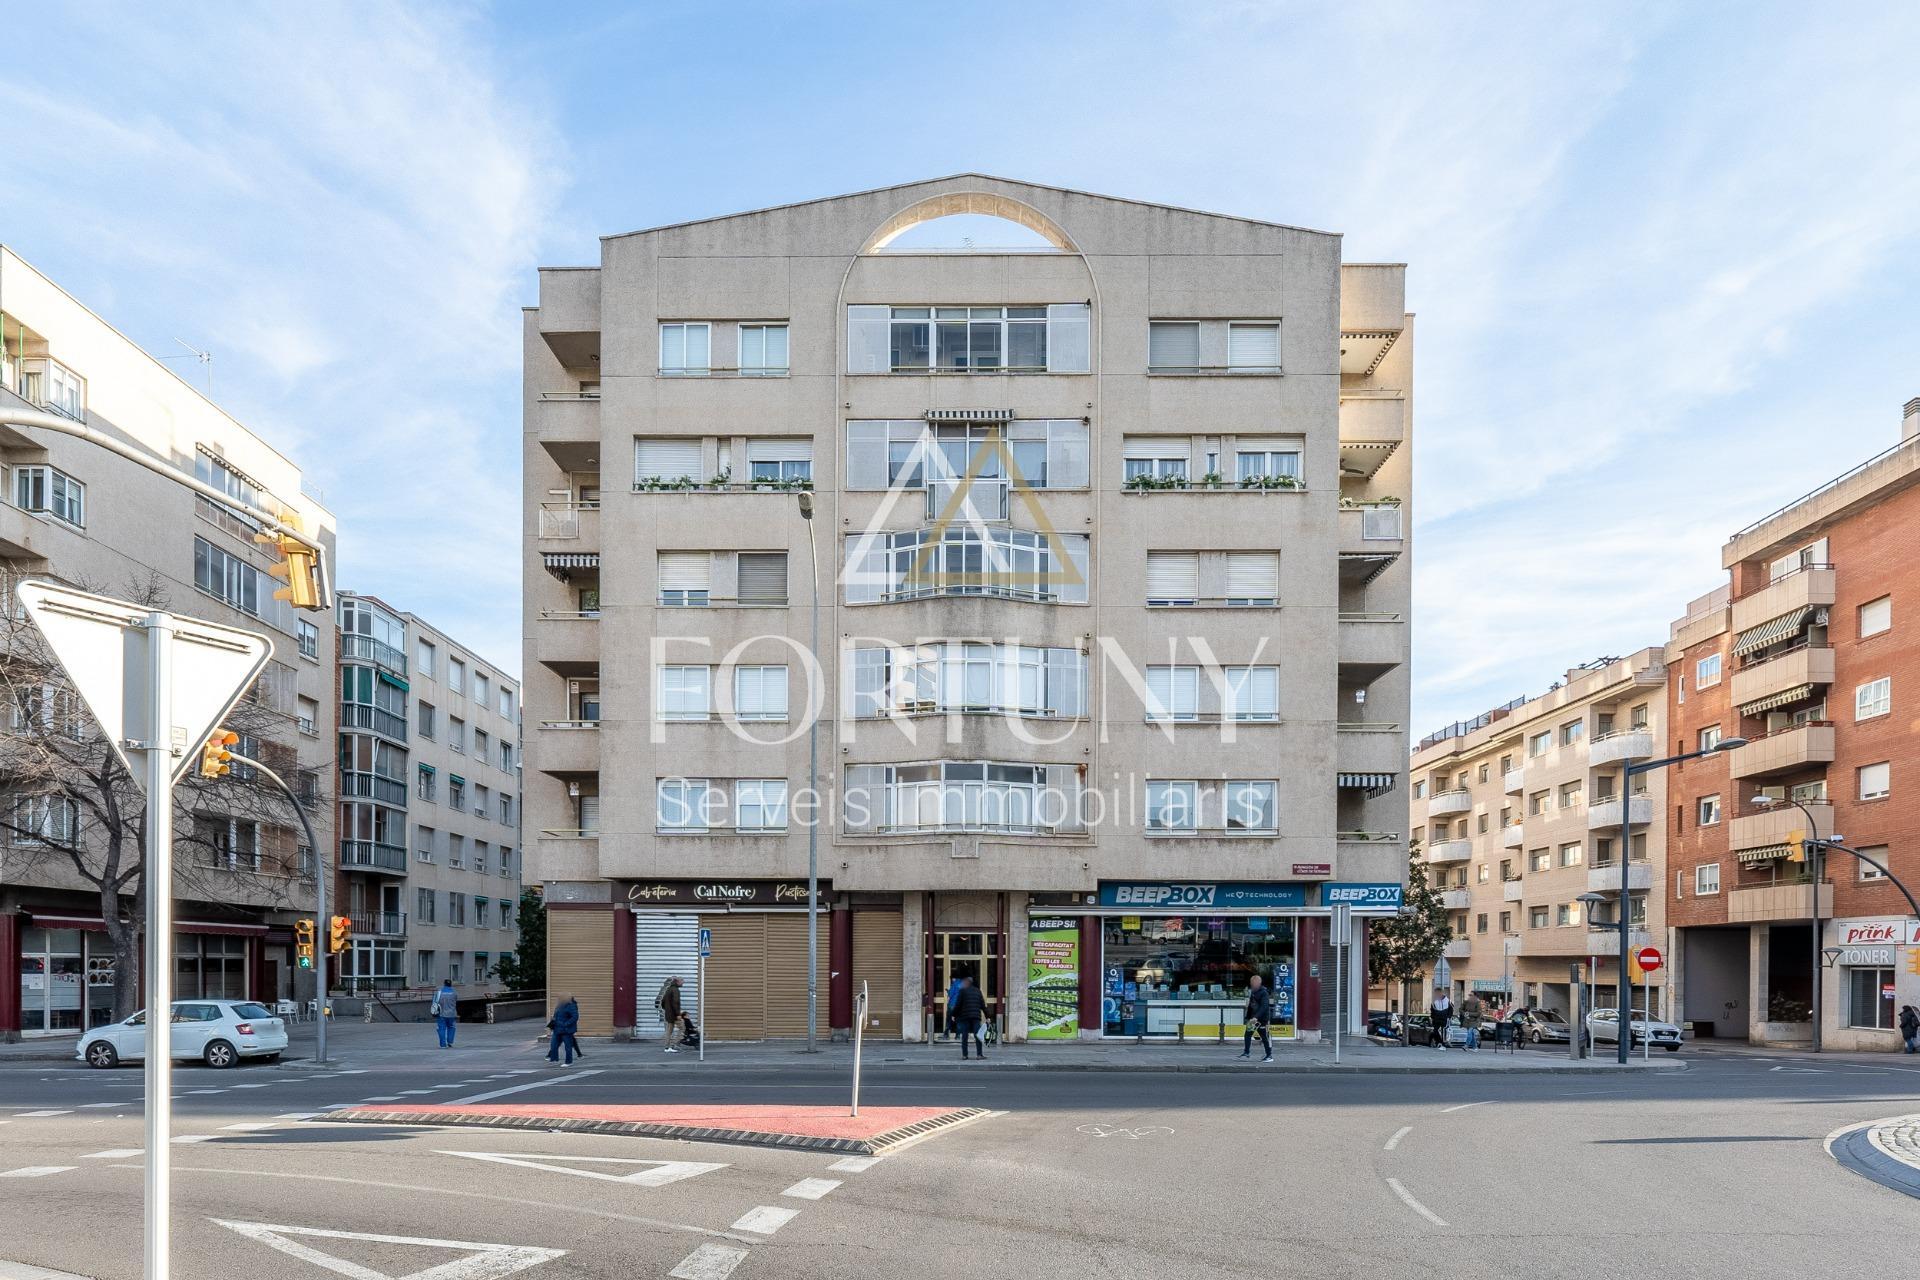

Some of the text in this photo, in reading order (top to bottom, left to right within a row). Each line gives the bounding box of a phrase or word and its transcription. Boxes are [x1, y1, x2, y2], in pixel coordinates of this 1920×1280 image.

[696, 885, 752, 897] Cal Nofre
[1115, 885, 1216, 905] BEEPBOX
[1329, 886, 1401, 902] BEEPBOX
[1031, 920, 1039, 928] A
[1040, 920, 1064, 928] BEEP
[1847, 925, 1896, 943] prink
